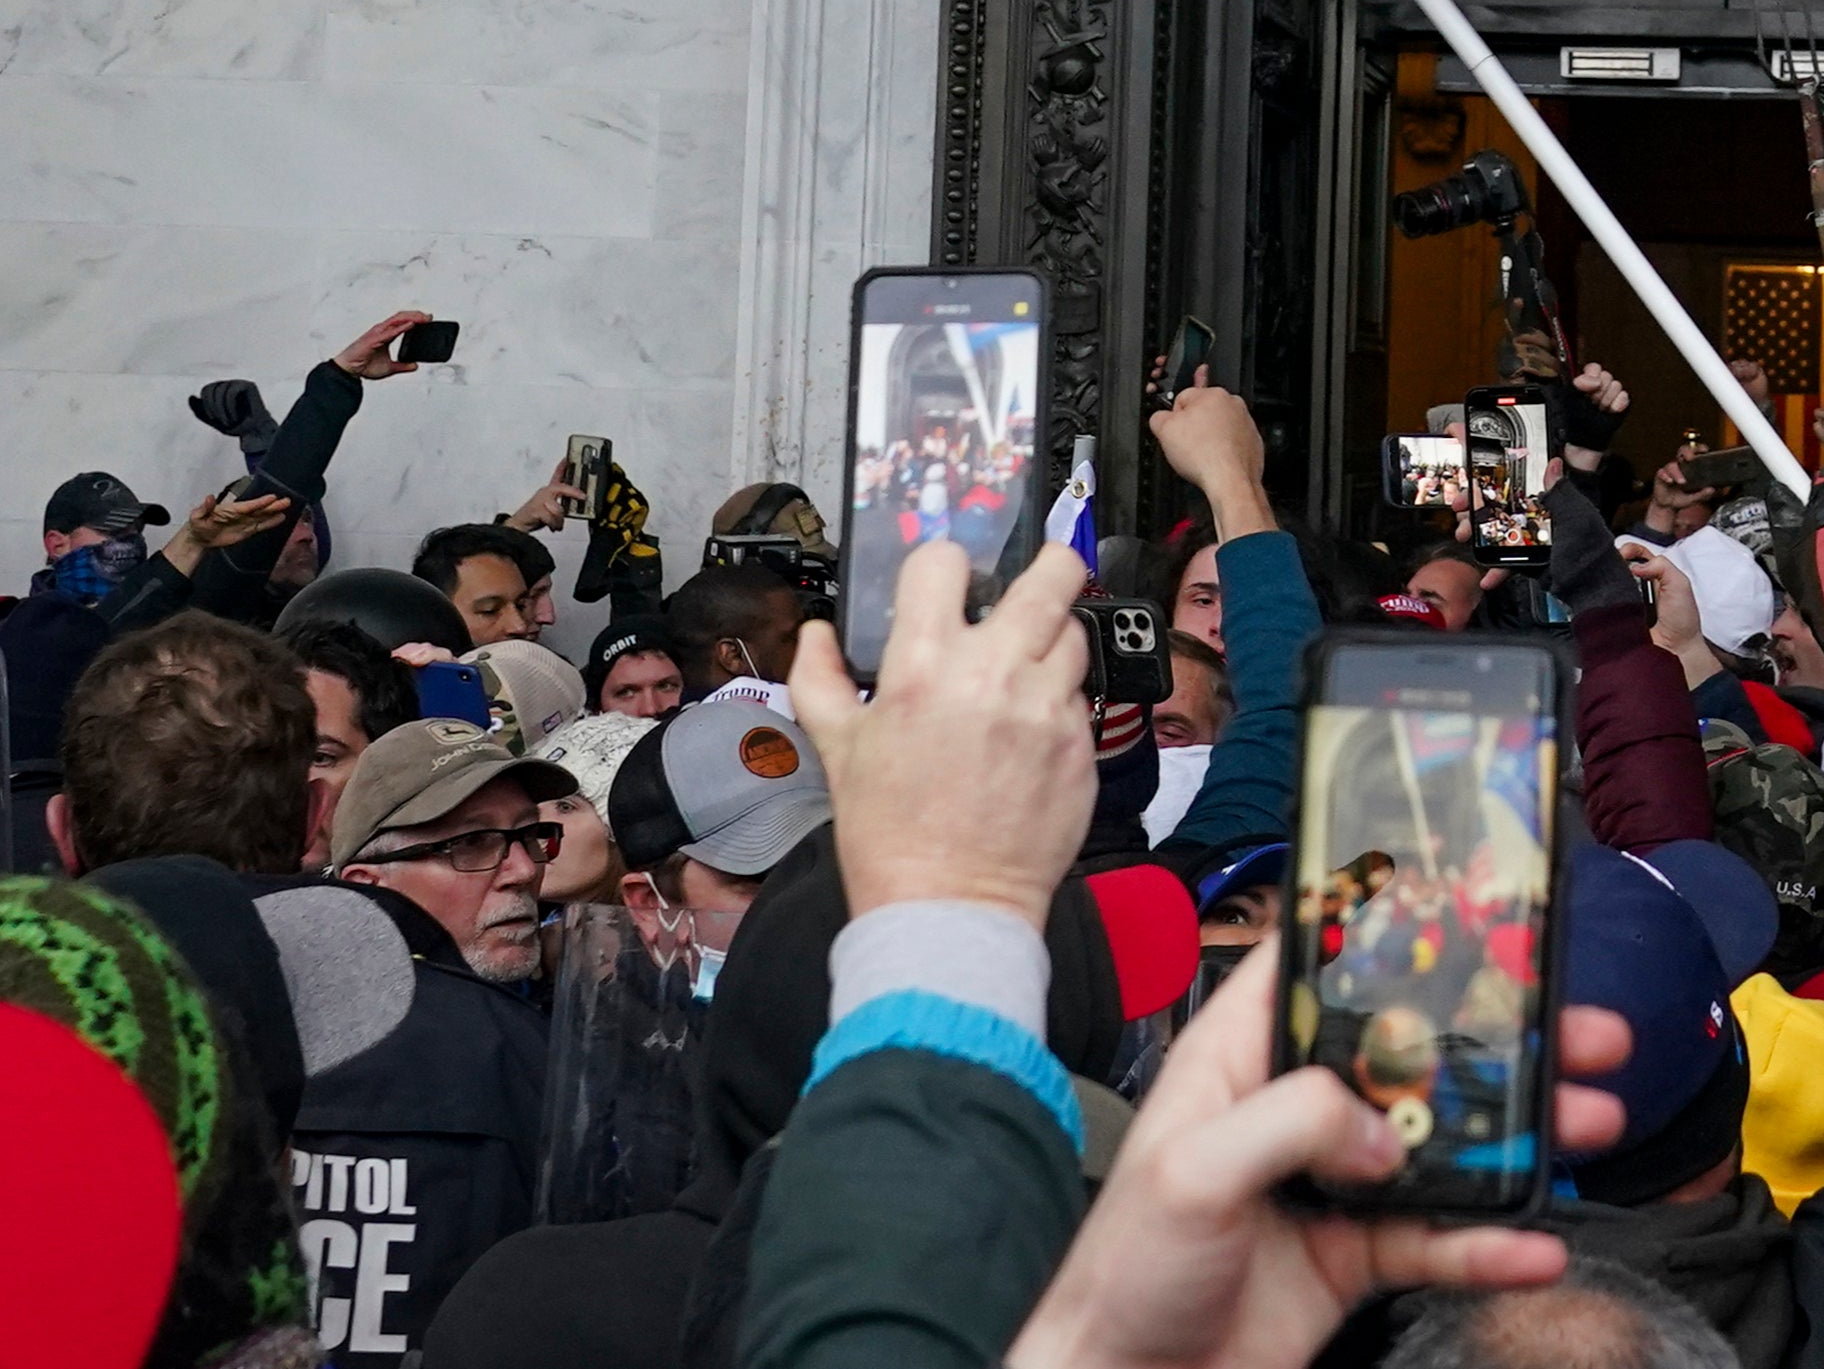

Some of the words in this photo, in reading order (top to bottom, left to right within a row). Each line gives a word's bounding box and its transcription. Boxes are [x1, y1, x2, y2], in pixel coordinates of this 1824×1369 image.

[603, 634, 637, 661] ORBIT
[431, 743, 469, 771] JOHN
[289, 1147, 417, 1215] PITOL
